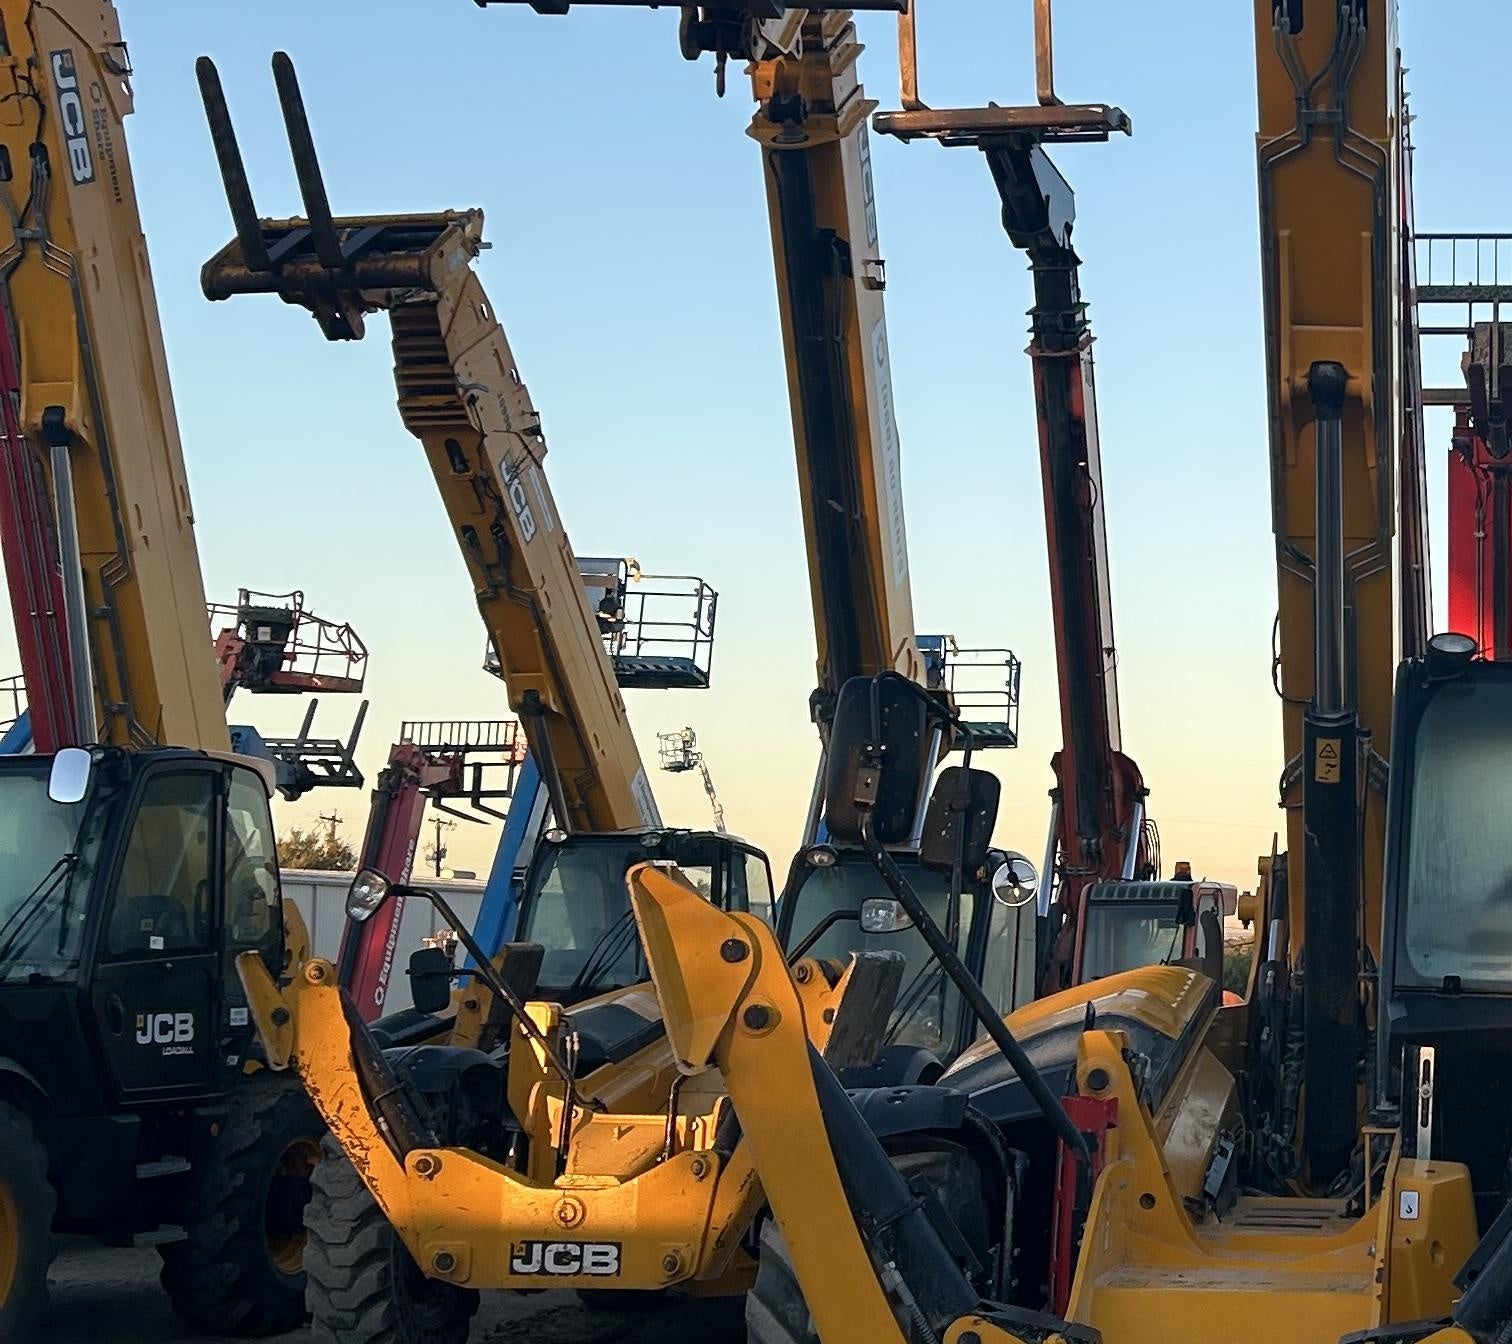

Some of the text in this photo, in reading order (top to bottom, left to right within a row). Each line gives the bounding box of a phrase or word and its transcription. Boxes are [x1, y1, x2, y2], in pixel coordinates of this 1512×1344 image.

[52, 54, 93, 182] JCB
[501, 459, 536, 542] JCB
[136, 1012, 194, 1044] JCB
[512, 1243, 619, 1274] JCB
